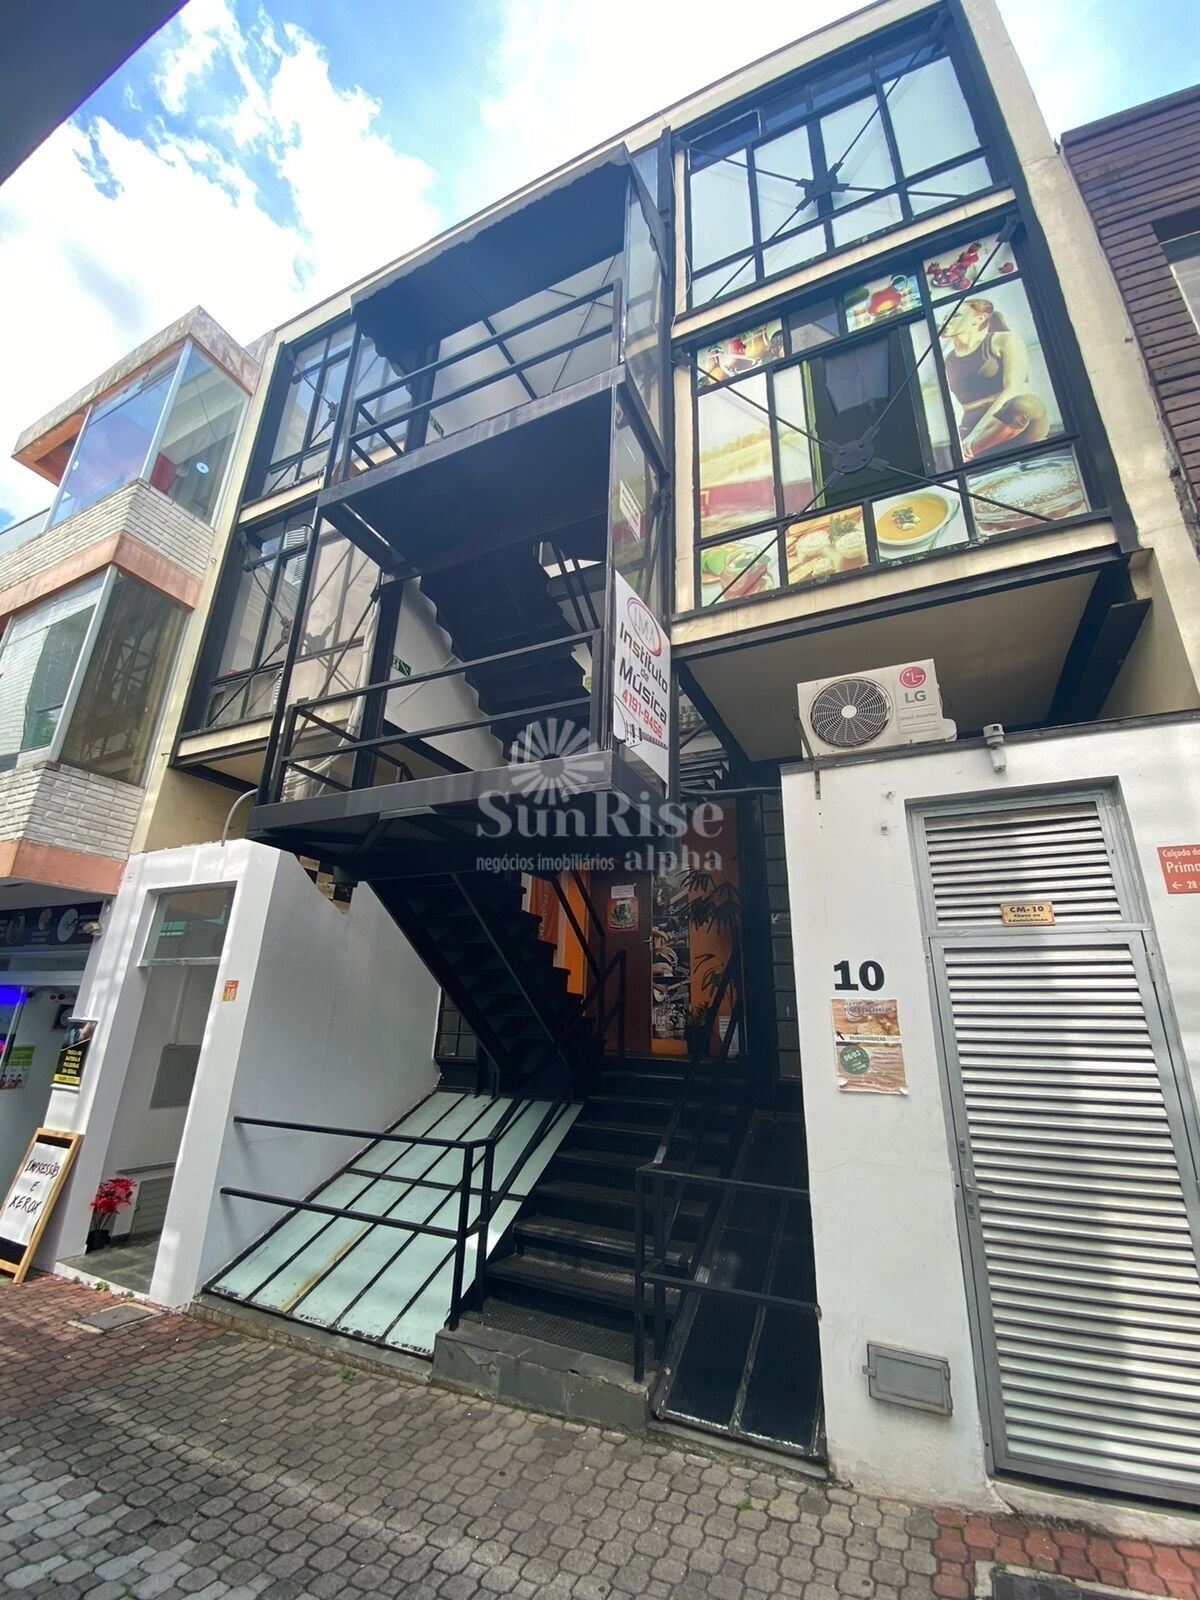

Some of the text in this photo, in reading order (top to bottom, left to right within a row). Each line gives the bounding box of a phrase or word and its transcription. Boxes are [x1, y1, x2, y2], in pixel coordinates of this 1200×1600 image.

[619, 621, 668, 694] Instituto
[640, 668, 649, 682] de
[619, 657, 667, 726] Música
[904, 690, 927, 704] LG
[1162, 849, 1191, 859] Calçada
[1186, 880, 1198, 889] 28
[833, 960, 885, 991] 10
[8, 1195, 42, 1214] XEROX
